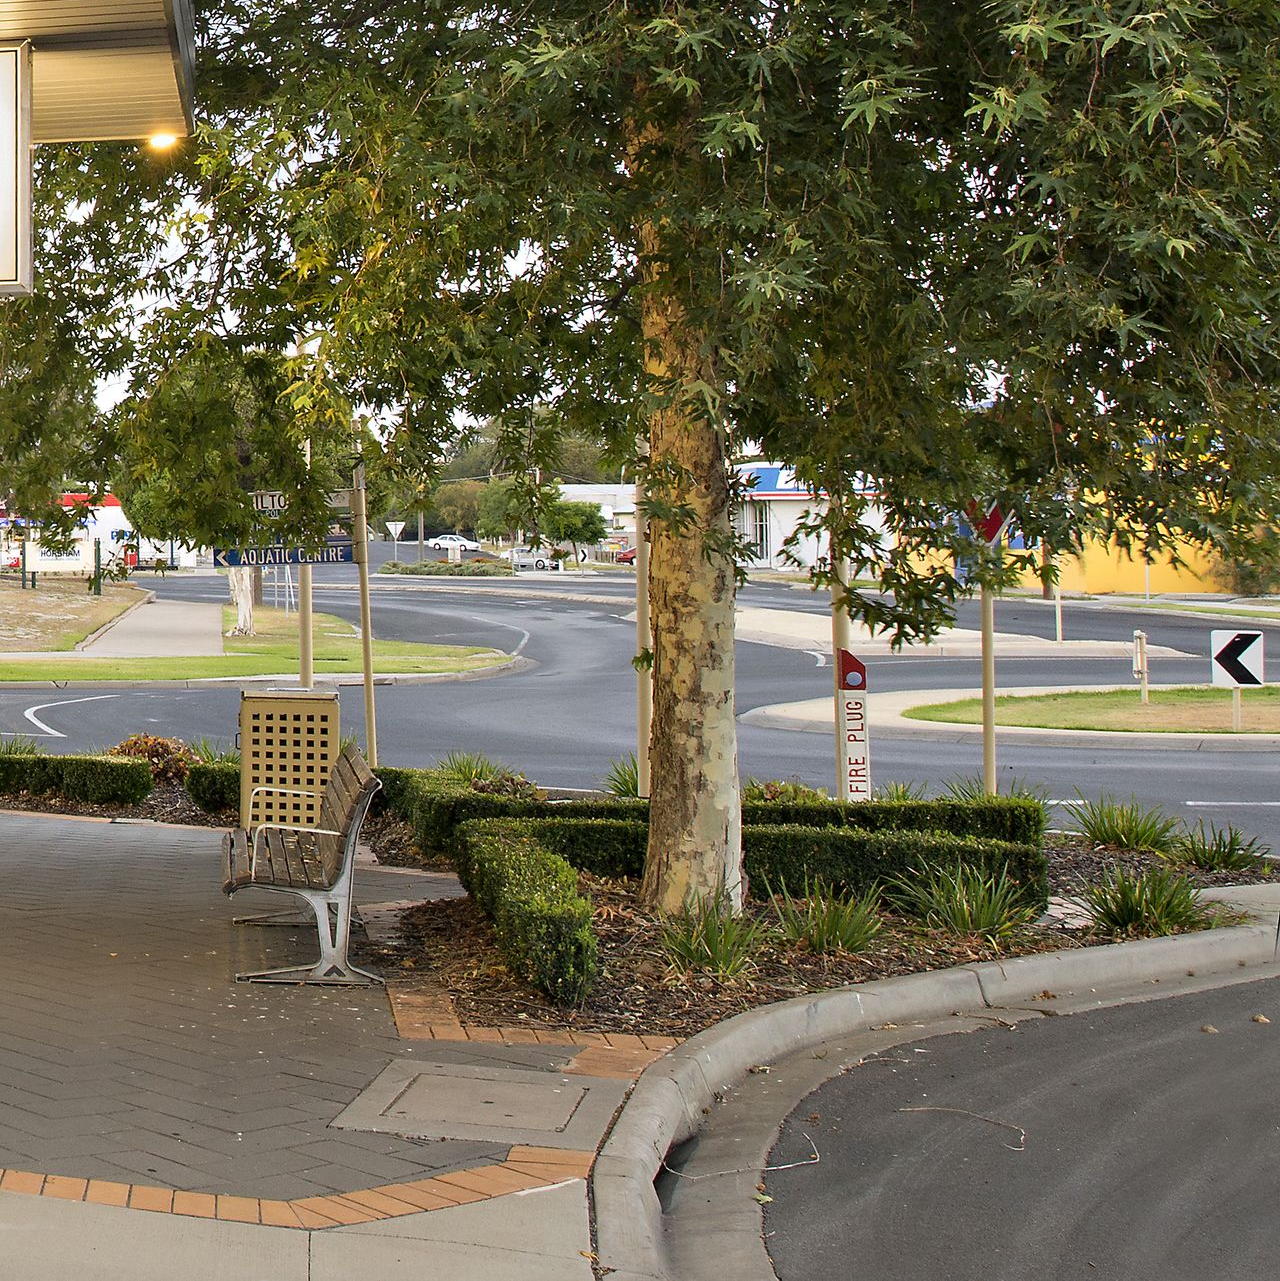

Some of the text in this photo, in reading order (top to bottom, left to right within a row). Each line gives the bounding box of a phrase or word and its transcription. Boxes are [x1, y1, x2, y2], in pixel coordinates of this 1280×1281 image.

[40, 549, 81, 558] HORSHAM
[240, 546, 345, 565] AQUATIC CENTRE
[846, 701, 867, 794] FIRE PLUG
